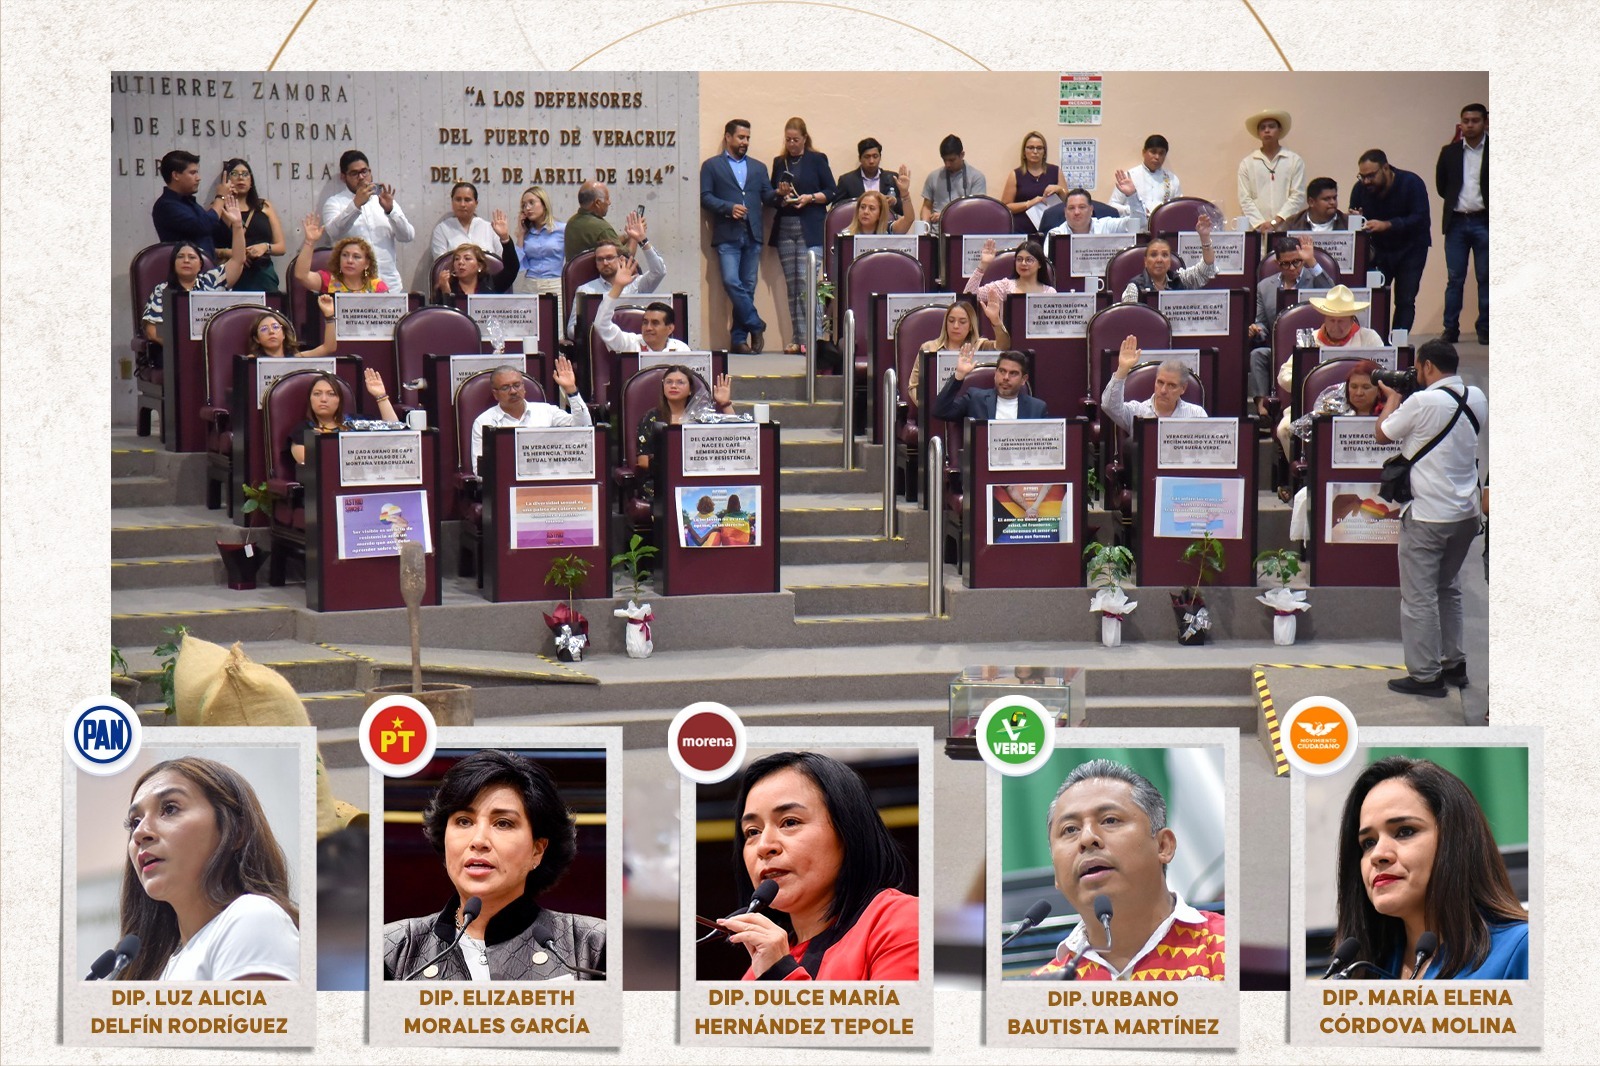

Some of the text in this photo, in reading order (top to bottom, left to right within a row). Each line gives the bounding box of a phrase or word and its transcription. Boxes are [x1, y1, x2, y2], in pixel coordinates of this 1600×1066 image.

[253, 82, 348, 103] ZAMORA
[494, 90, 525, 106] LOS
[535, 92, 642, 108] DEFENSORES
[134, 117, 352, 141] DE JESUS CORONA
[440, 128, 675, 146] DEL PUERTO DE VERACRUZ
[431, 167, 461, 182] DEL
[472, 168, 490, 183] 21
[502, 168, 523, 183] DE
[533, 168, 586, 184] ABRIL
[596, 168, 616, 183] DE
